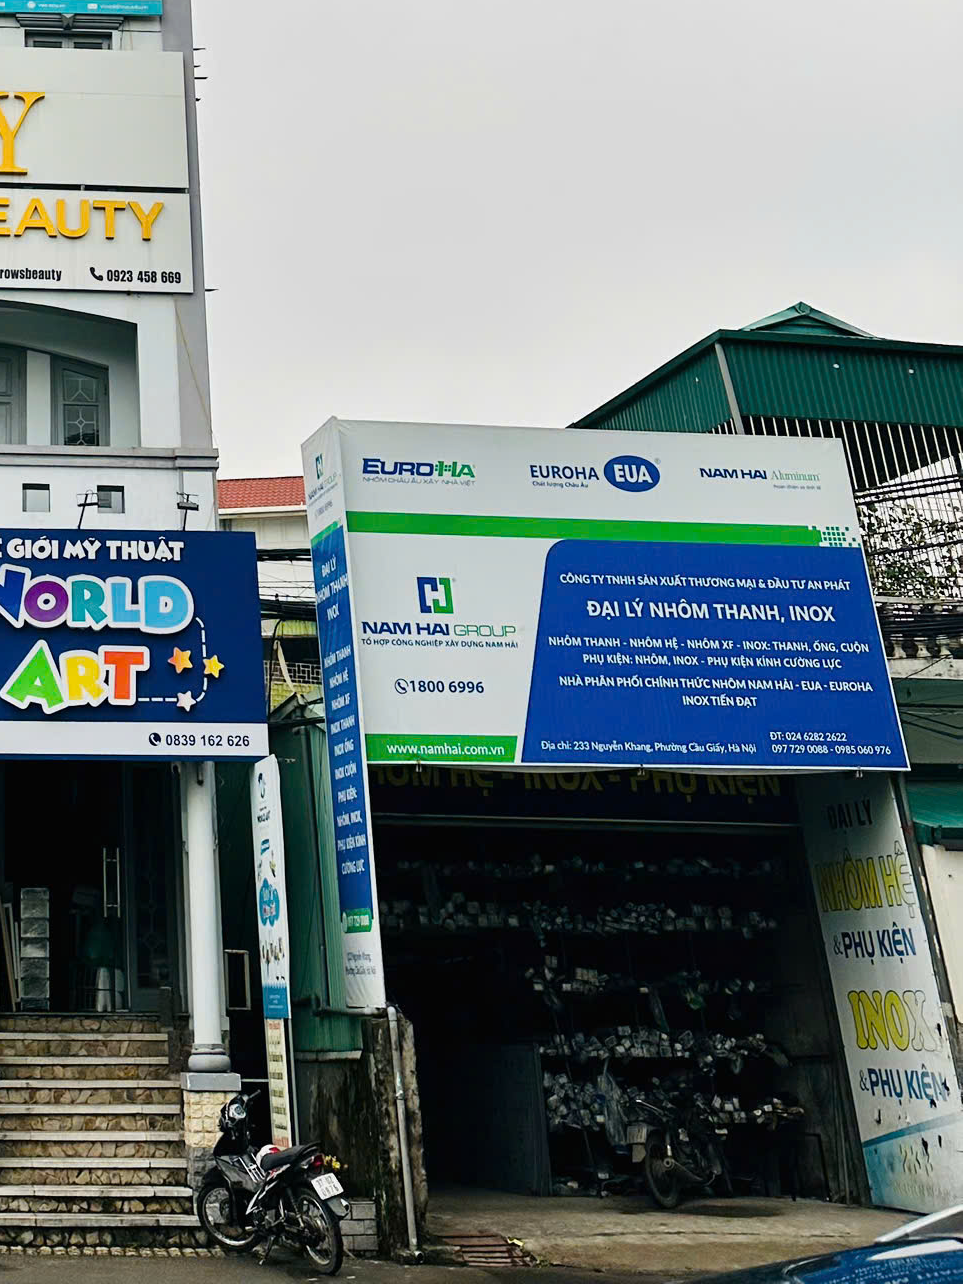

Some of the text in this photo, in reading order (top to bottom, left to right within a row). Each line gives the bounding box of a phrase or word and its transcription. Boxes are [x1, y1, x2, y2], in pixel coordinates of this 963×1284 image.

[107, 270, 181, 284] 0923 458 669
[530, 465, 599, 480] EUROHA
[613, 464, 653, 484] EUA
[699, 468, 738, 478] NAM
[741, 469, 767, 479] HAI
[6, 536, 59, 559] GIỚI
[63, 538, 101, 560] MỸ
[106, 536, 184, 562] THUẬT
[560, 572, 590, 584] CÔNG
[591, 575, 604, 584] TY
[606, 575, 635, 585] TNHH
[660, 575, 686, 586] XUẤT
[688, 577, 735, 587] THƯƠNG
[736, 579, 756, 590] MẠI
[767, 577, 789, 589] ĐẦU
[791, 579, 806, 589] TƯ
[808, 580, 822, 590] AN
[824, 579, 850, 590] PHÁT
[587, 598, 836, 623] ĐẠI LÝ NHÔM THANH, INOX
[362, 622, 516, 637] NAM HAI GROUP
[392, 638, 413, 646] CÔNG
[415, 639, 444, 648] NGHIỆP
[461, 641, 484, 649] DỰNG
[549, 635, 869, 654] NHÔM THANH NHÔM HỆ NHÔM XF INOX: THANH, ỐNG, CUỘN
[583, 652, 842, 670] PHỤ KIỆN: NHÔM, INOX PHỤ KIỆN KÍNH CƯỜNG LỰC
[0, 640, 150, 714] ART
[559, 674, 584, 686] NHÀ
[585, 675, 615, 687] PHÂN
[617, 675, 643, 687] PHỐI
[645, 676, 678, 688] CHÍNH
[680, 676, 710, 689] THỨC
[712, 677, 746, 689] NHÔM
[748, 680, 773, 689] NAM
[801, 681, 822, 691] EUA
[829, 682, 873, 692] EUROHA
[410, 680, 484, 693] 1800 6996
[683, 693, 757, 708] INOX TIẾN ĐẠT
[166, 735, 250, 746] 0839 162 626
[770, 732, 847, 741] ĐT: 024 6282 2622
[387, 743, 504, 755] www.namhai.com.vn
[541, 740, 756, 754] Địa chỉ: 233 Nguyễn Khang, Phường Cầu Giấy, Hà Nội
[772, 744, 891, 755] 097 729 0088 0985 060 976
[816, 840, 916, 918] NHÔM HỆ
[876, 922, 916, 963] KIỆN
[848, 990, 939, 1051] INOX
[905, 1063, 947, 1108] KIỆN
